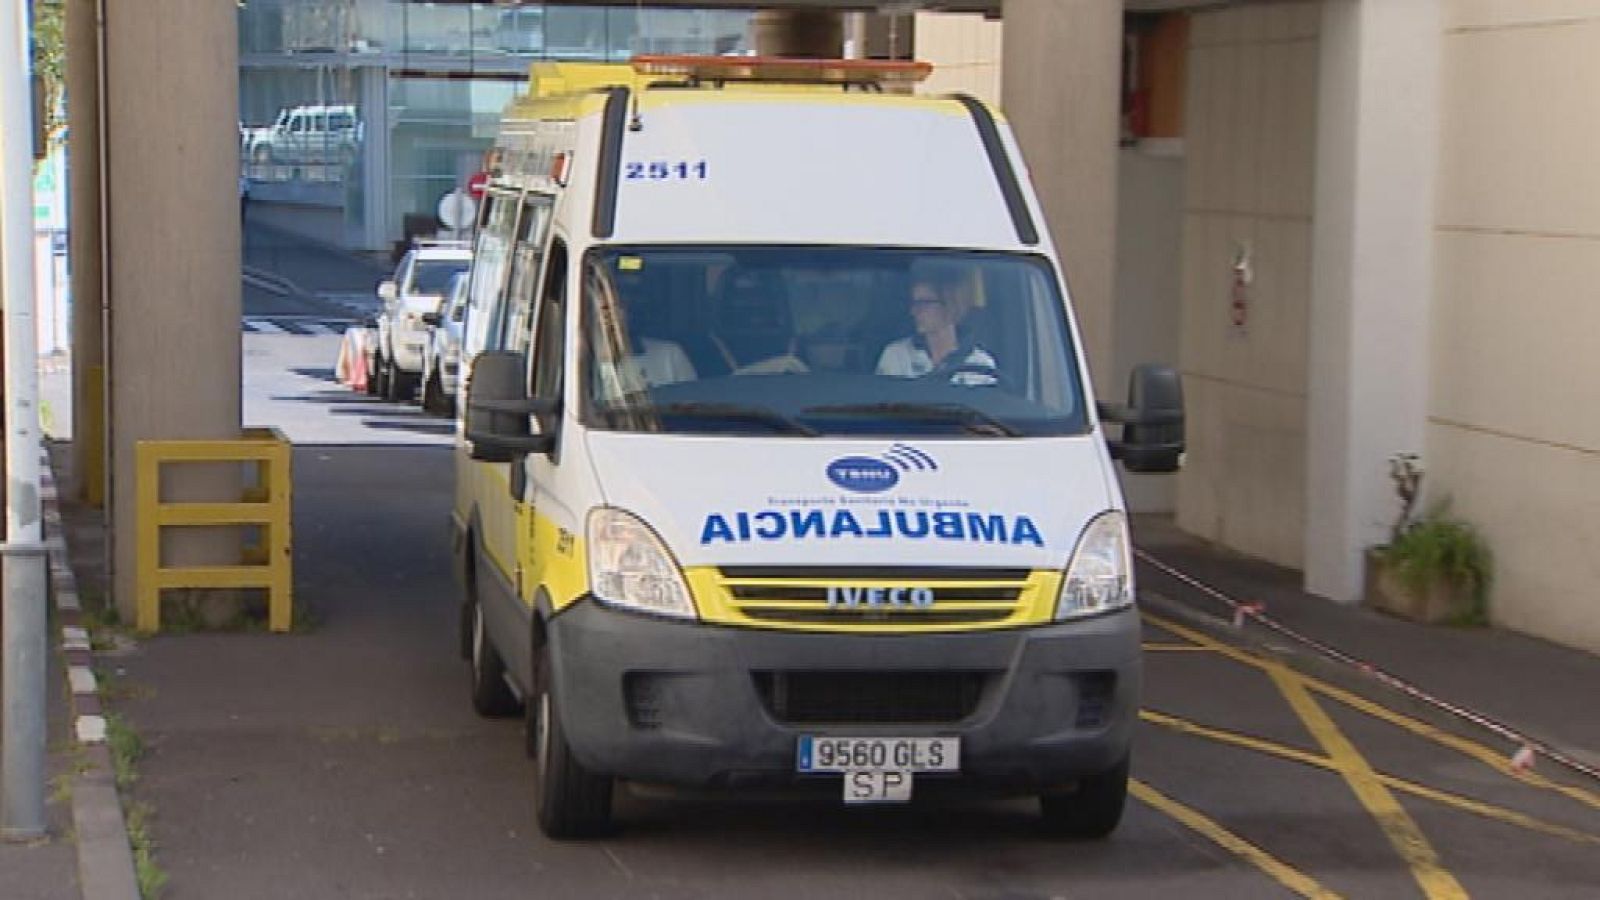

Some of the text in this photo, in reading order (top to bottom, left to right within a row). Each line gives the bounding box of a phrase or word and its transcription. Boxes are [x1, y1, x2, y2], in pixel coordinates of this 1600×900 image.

[626, 161, 706, 179] 2511
[827, 586, 934, 608] IVECO
[818, 740, 944, 767] 9560 GLS
